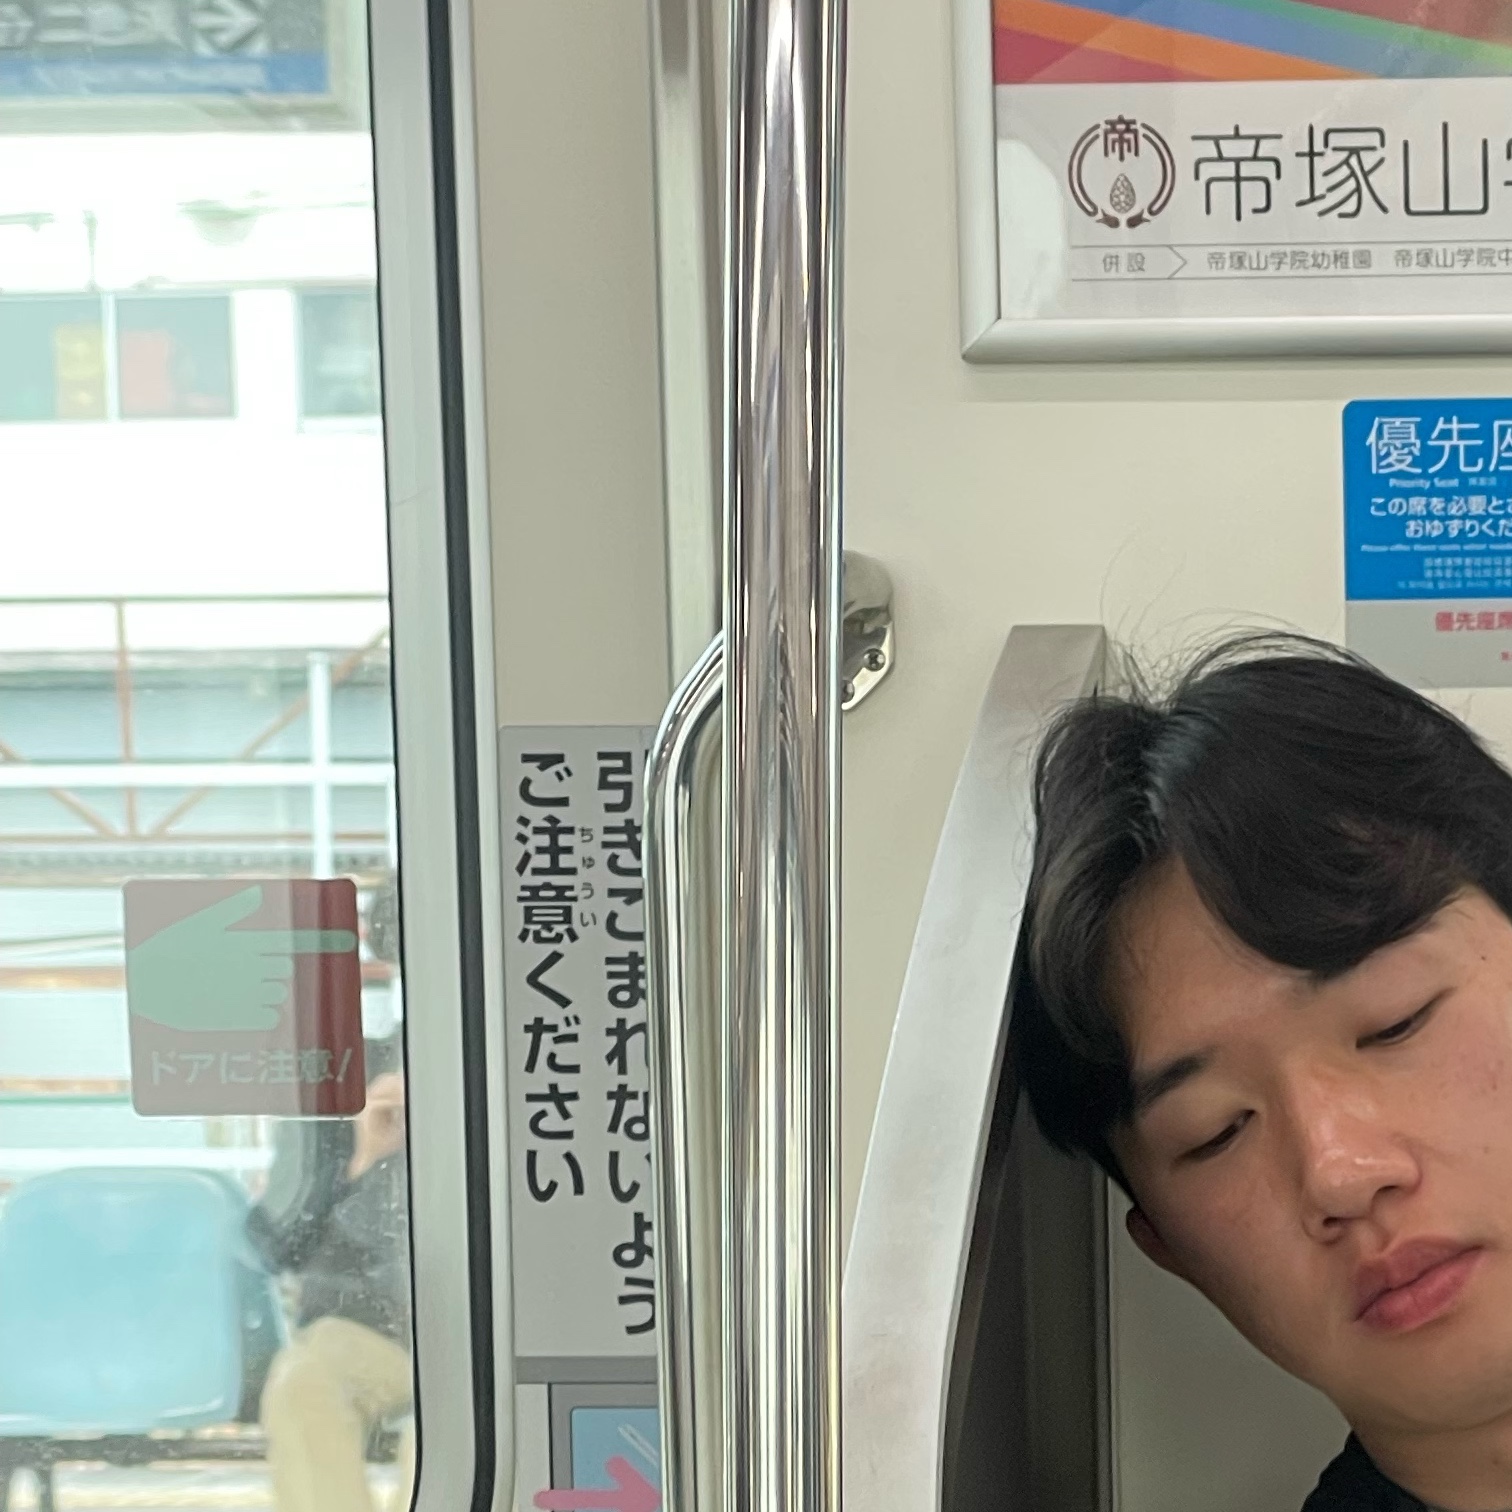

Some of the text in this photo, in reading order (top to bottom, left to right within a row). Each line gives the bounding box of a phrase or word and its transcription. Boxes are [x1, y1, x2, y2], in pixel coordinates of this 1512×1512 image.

[514, 752, 585, 1204] ご注意ください
